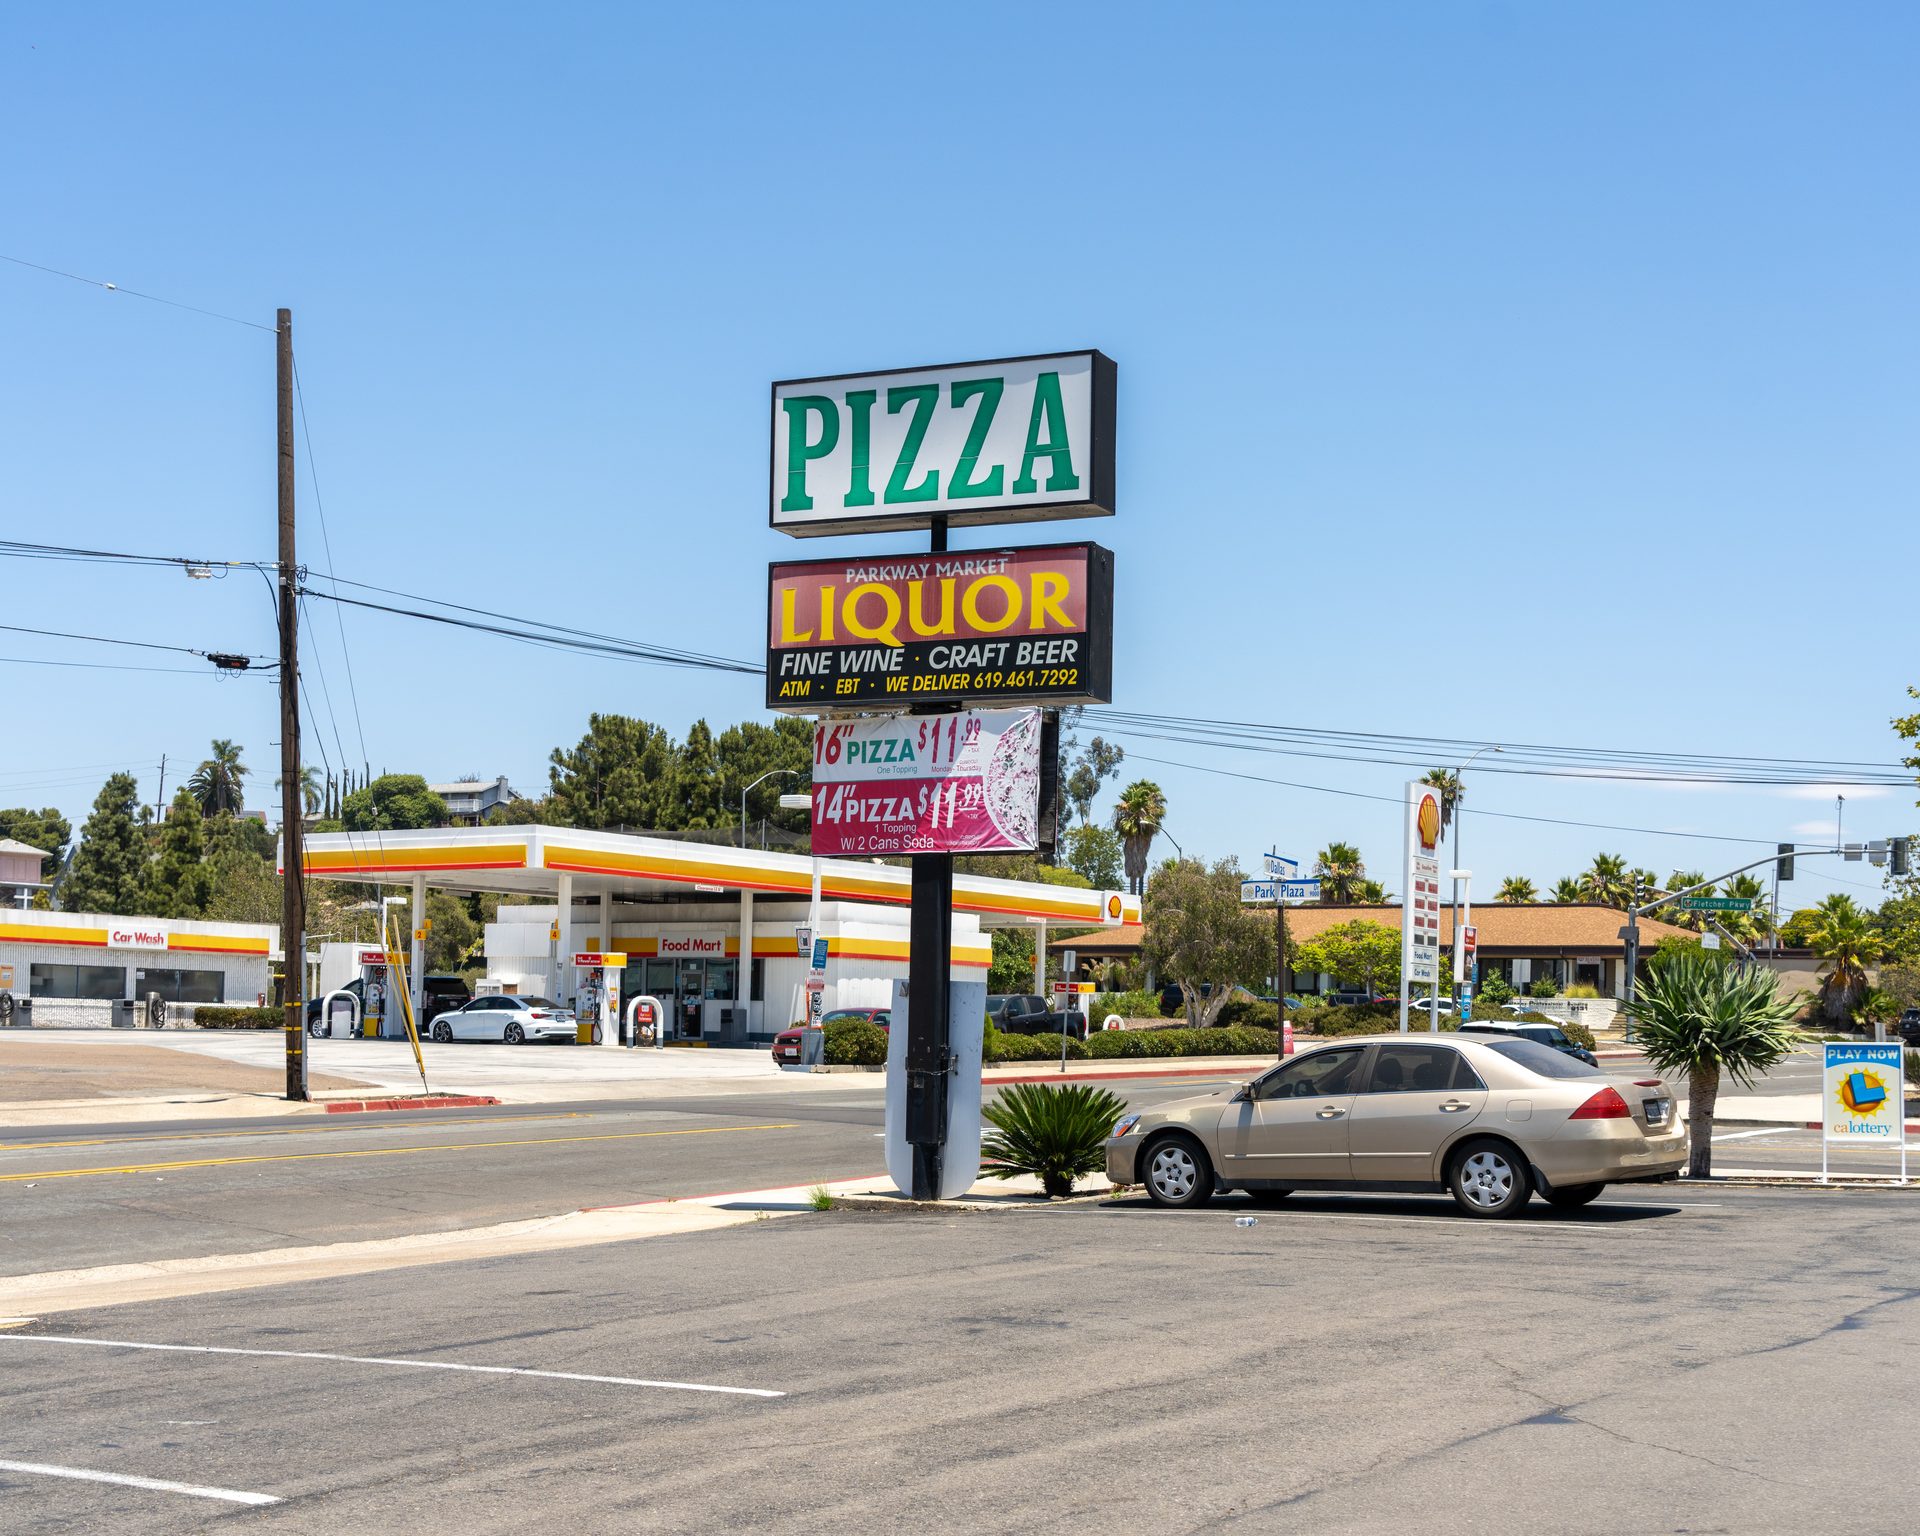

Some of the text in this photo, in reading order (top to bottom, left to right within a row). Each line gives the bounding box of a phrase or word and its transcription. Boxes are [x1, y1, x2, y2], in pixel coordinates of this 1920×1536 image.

[781, 371, 1080, 512] PIZZA
[846, 558, 1009, 583] PARKWAY MARKET
[781, 571, 1077, 647] LIQUOR
[780, 639, 1079, 676] FINE WINE CRAFT BEER
[779, 668, 1078, 697] ATM EBT WE DELIVER 619.461.7292
[815, 724, 855, 765] 16"
[847, 738, 915, 765] PIZZA
[877, 765, 918, 775] One Topping
[956, 764, 982, 773] Thursday
[816, 784, 856, 825] 14"
[846, 797, 915, 823] PIZZA
[874, 823, 917, 834] 1 Topping
[841, 837, 855, 850] W/
[858, 836, 865, 850] 2
[868, 835, 899, 850] Cans
[902, 834, 934, 848] Soda
[1270, 860, 1286, 876] Dallas
[1254, 884, 1276, 898] Park
[1280, 884, 1305, 898] Plaza
[1693, 900, 1750, 909] Fletcher Pkwy
[113, 931, 164, 945] Car Wash
[662, 938, 721, 951] Food Mart
[1414, 951, 1423, 959] Food
[1827, 1049, 1899, 1060] PLAY NOW
[1833, 1120, 1891, 1137] calottery
